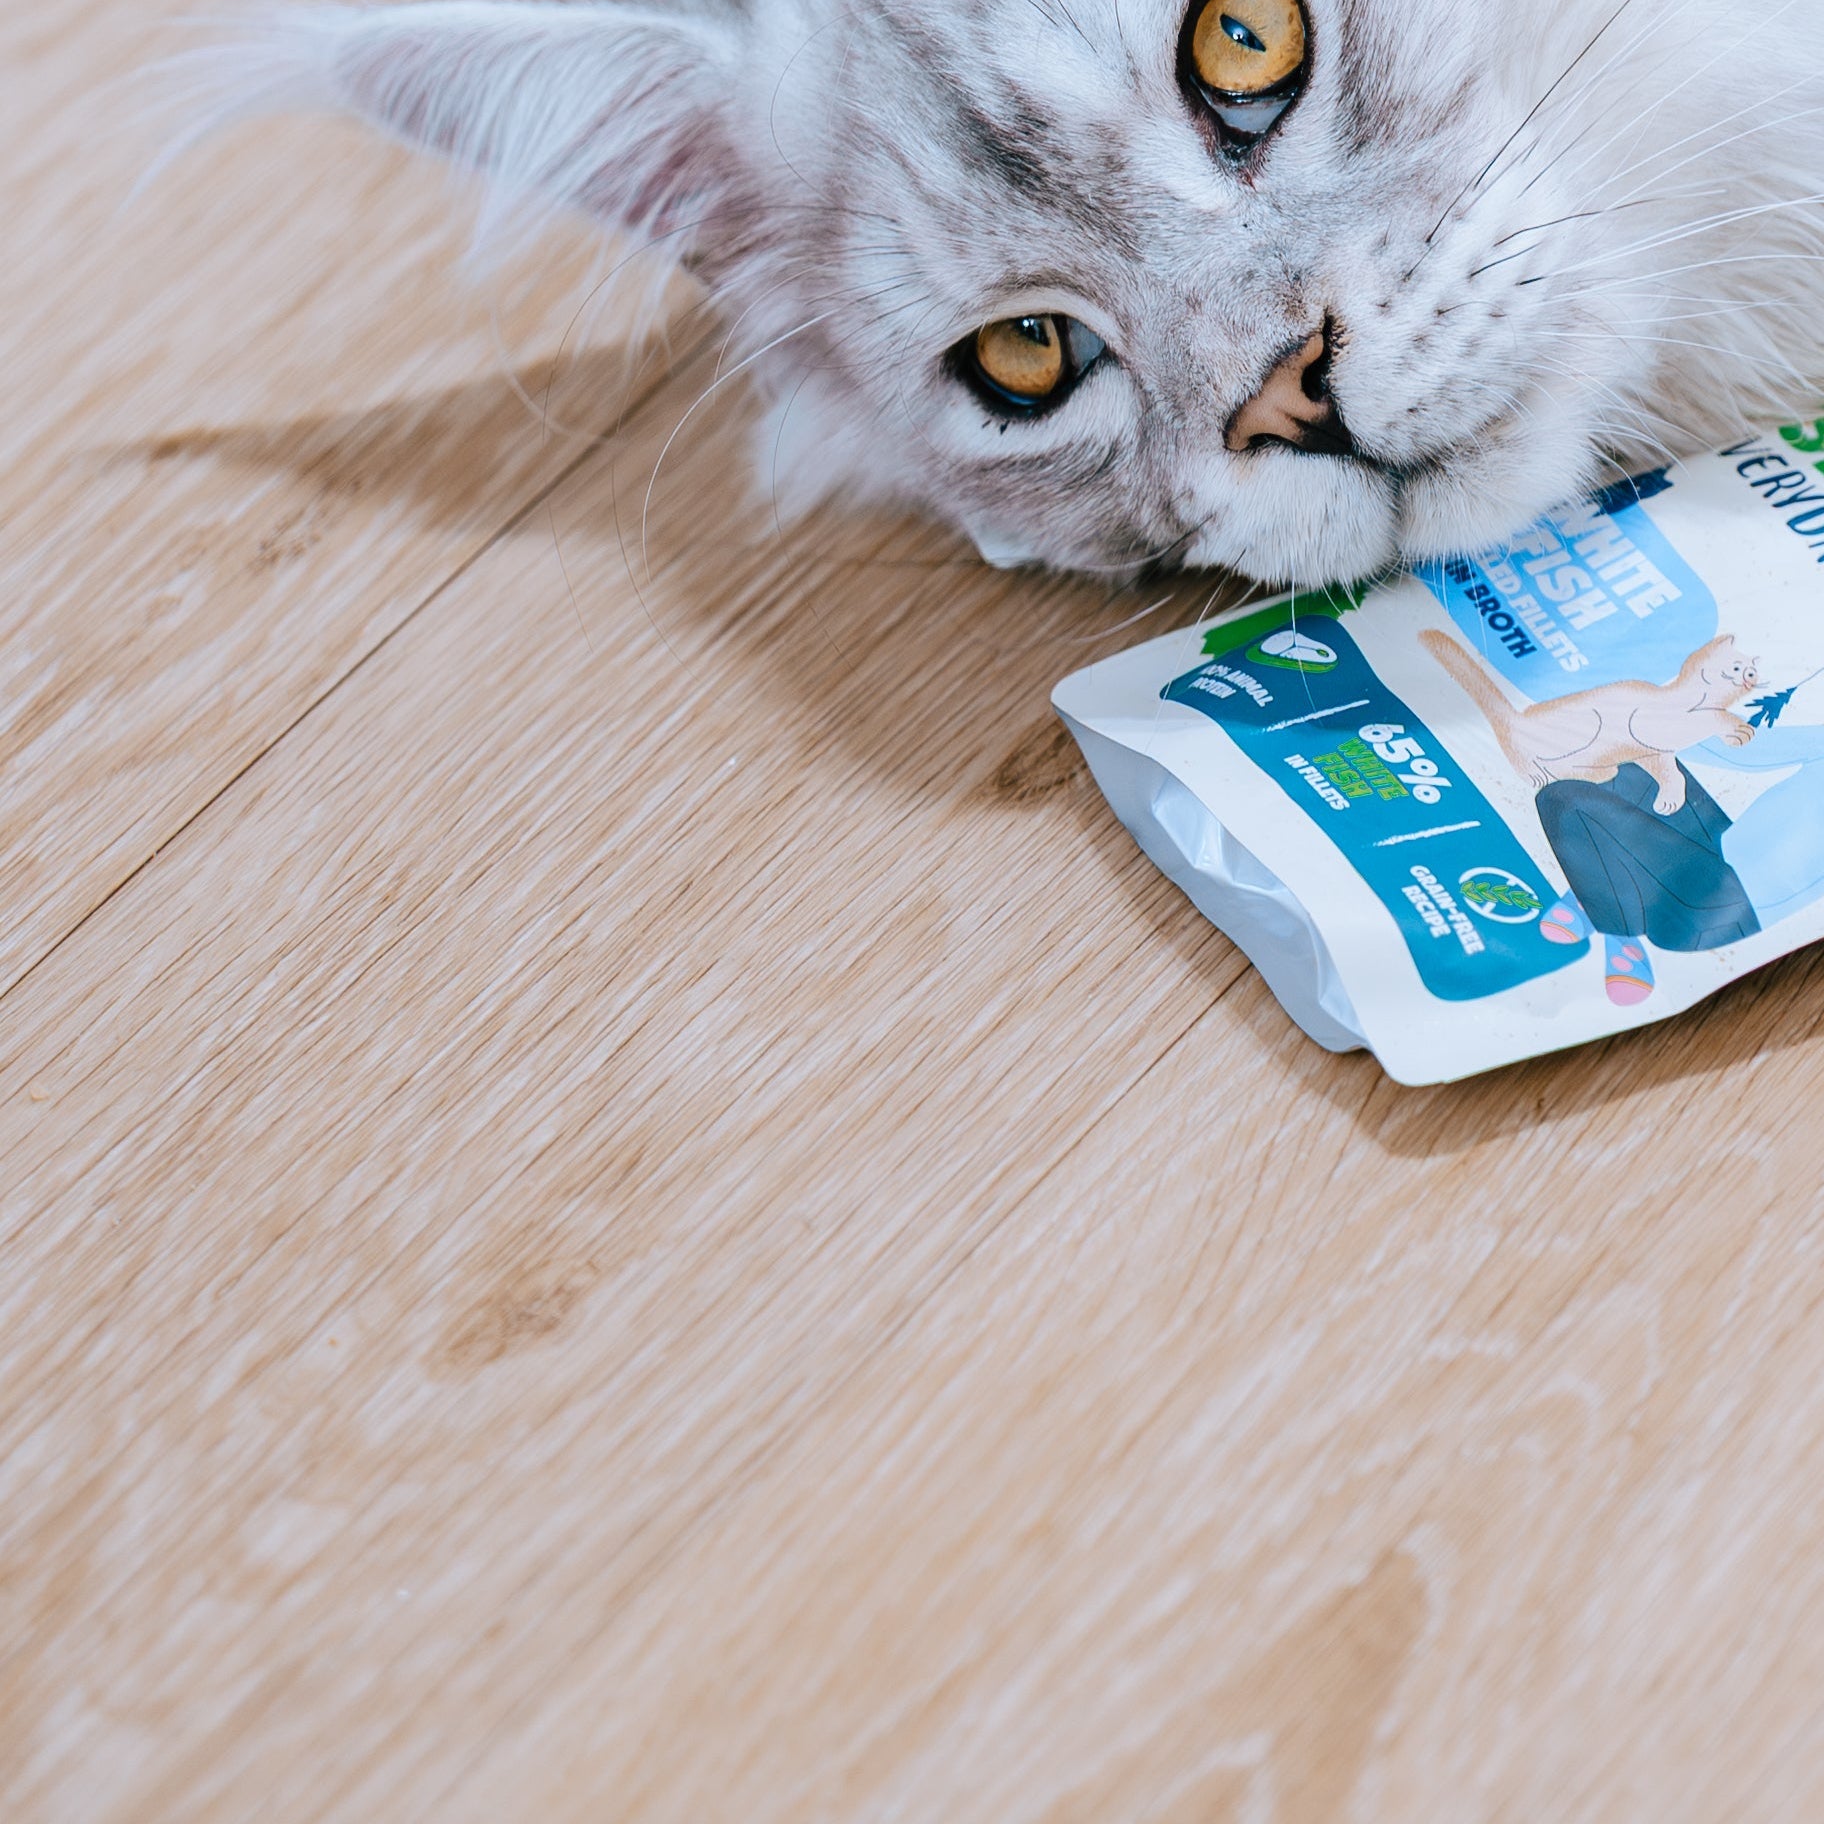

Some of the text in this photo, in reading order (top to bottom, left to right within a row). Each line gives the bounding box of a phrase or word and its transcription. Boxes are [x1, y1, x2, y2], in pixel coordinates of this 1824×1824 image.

[1510, 528, 1619, 631] FISH
[1464, 580, 1538, 659] BROTH
[1509, 593, 1590, 673] FILLETS
[1283, 754, 1350, 810] IN FILLETS
[1313, 752, 1374, 798] FISH
[1337, 737, 1409, 801] WHITE
[1358, 723, 1452, 804] 65%
[1401, 884, 1451, 938] RECIPE
[1410, 865, 1486, 955] GRAIN-FREE
